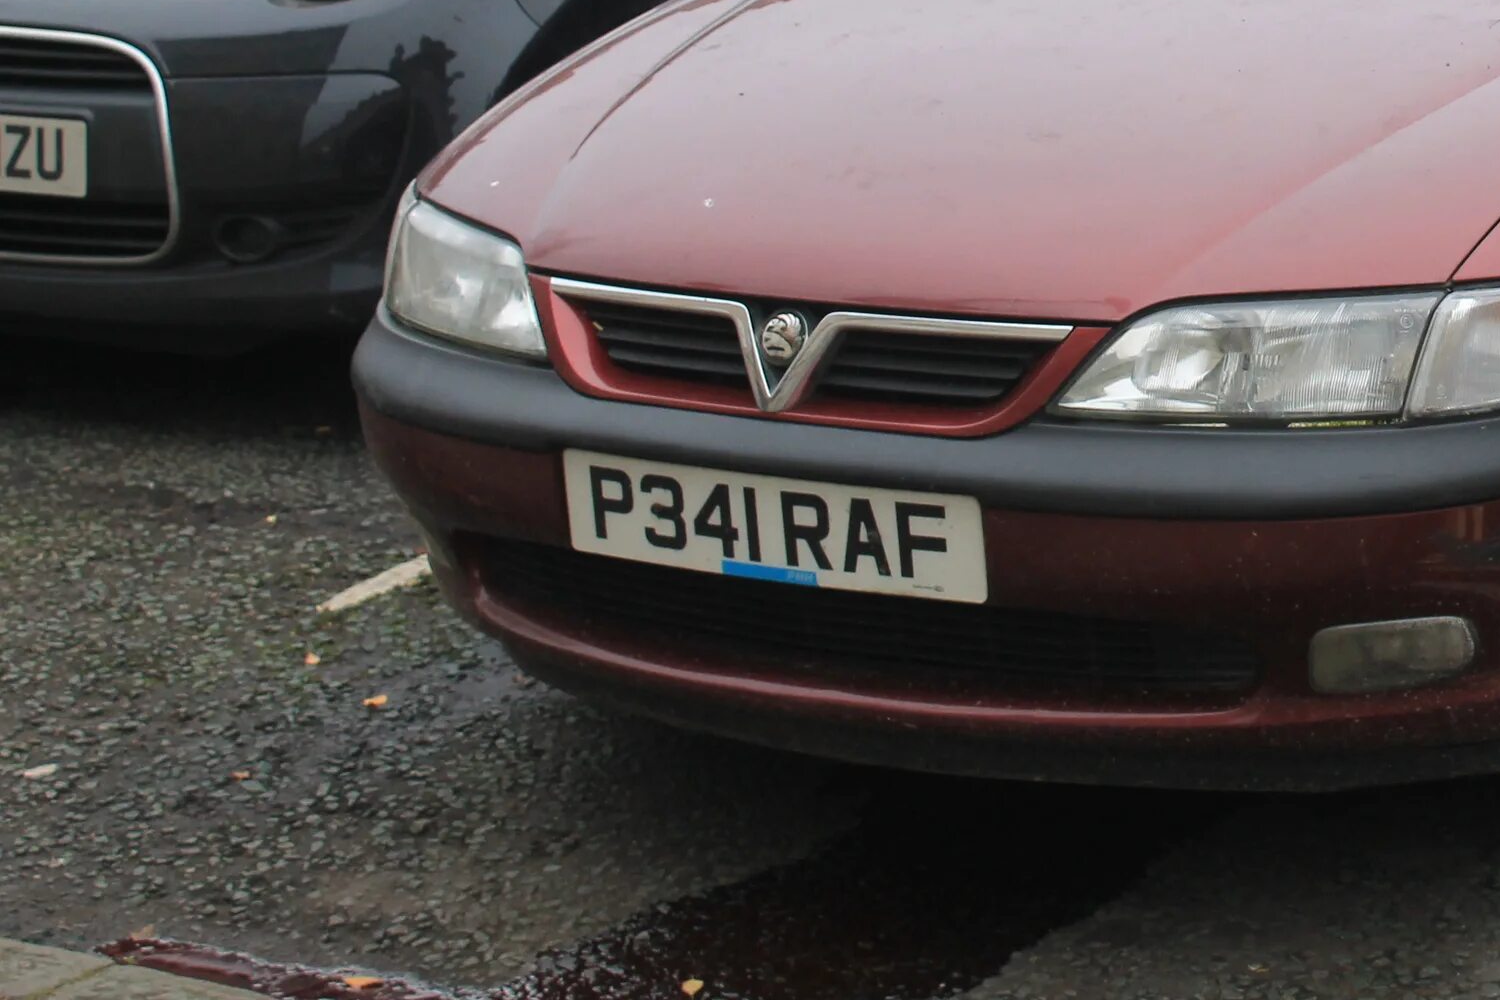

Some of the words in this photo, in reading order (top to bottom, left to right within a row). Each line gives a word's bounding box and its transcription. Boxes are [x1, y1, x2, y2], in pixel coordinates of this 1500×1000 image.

[5, 124, 64, 181] ZU
[589, 465, 762, 563] P341
[780, 490, 947, 579] RAF
